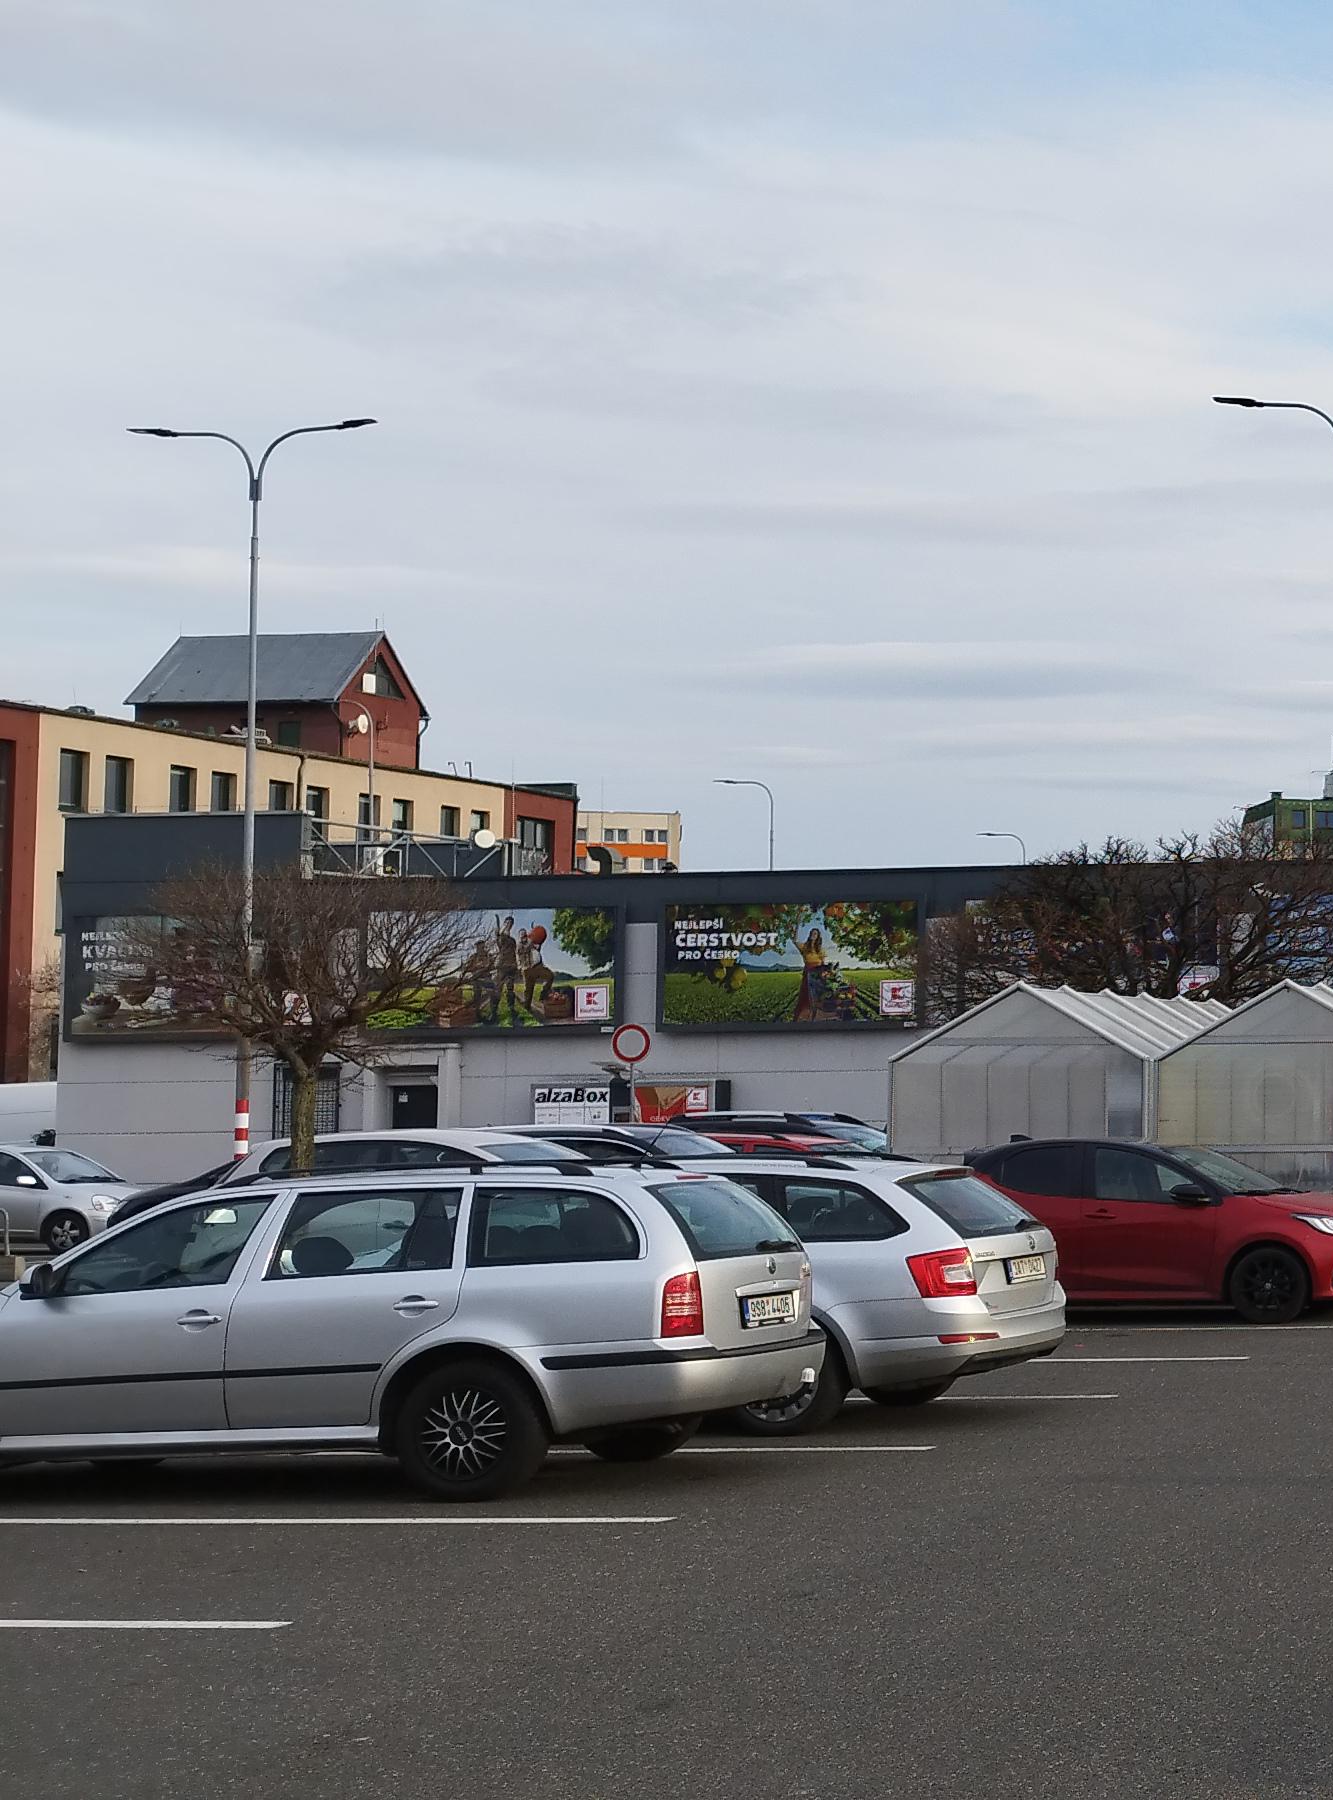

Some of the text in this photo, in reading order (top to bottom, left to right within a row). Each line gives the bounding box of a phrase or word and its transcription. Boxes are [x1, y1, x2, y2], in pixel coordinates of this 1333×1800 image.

[674, 917, 723, 930] NEJLEPŠÍ
[675, 930, 778, 947] ČERSTVOST
[678, 949, 740, 960] PRO ČESKO
[535, 1087, 608, 1103] alzaBox
[772, 1296, 790, 1314] 4405
